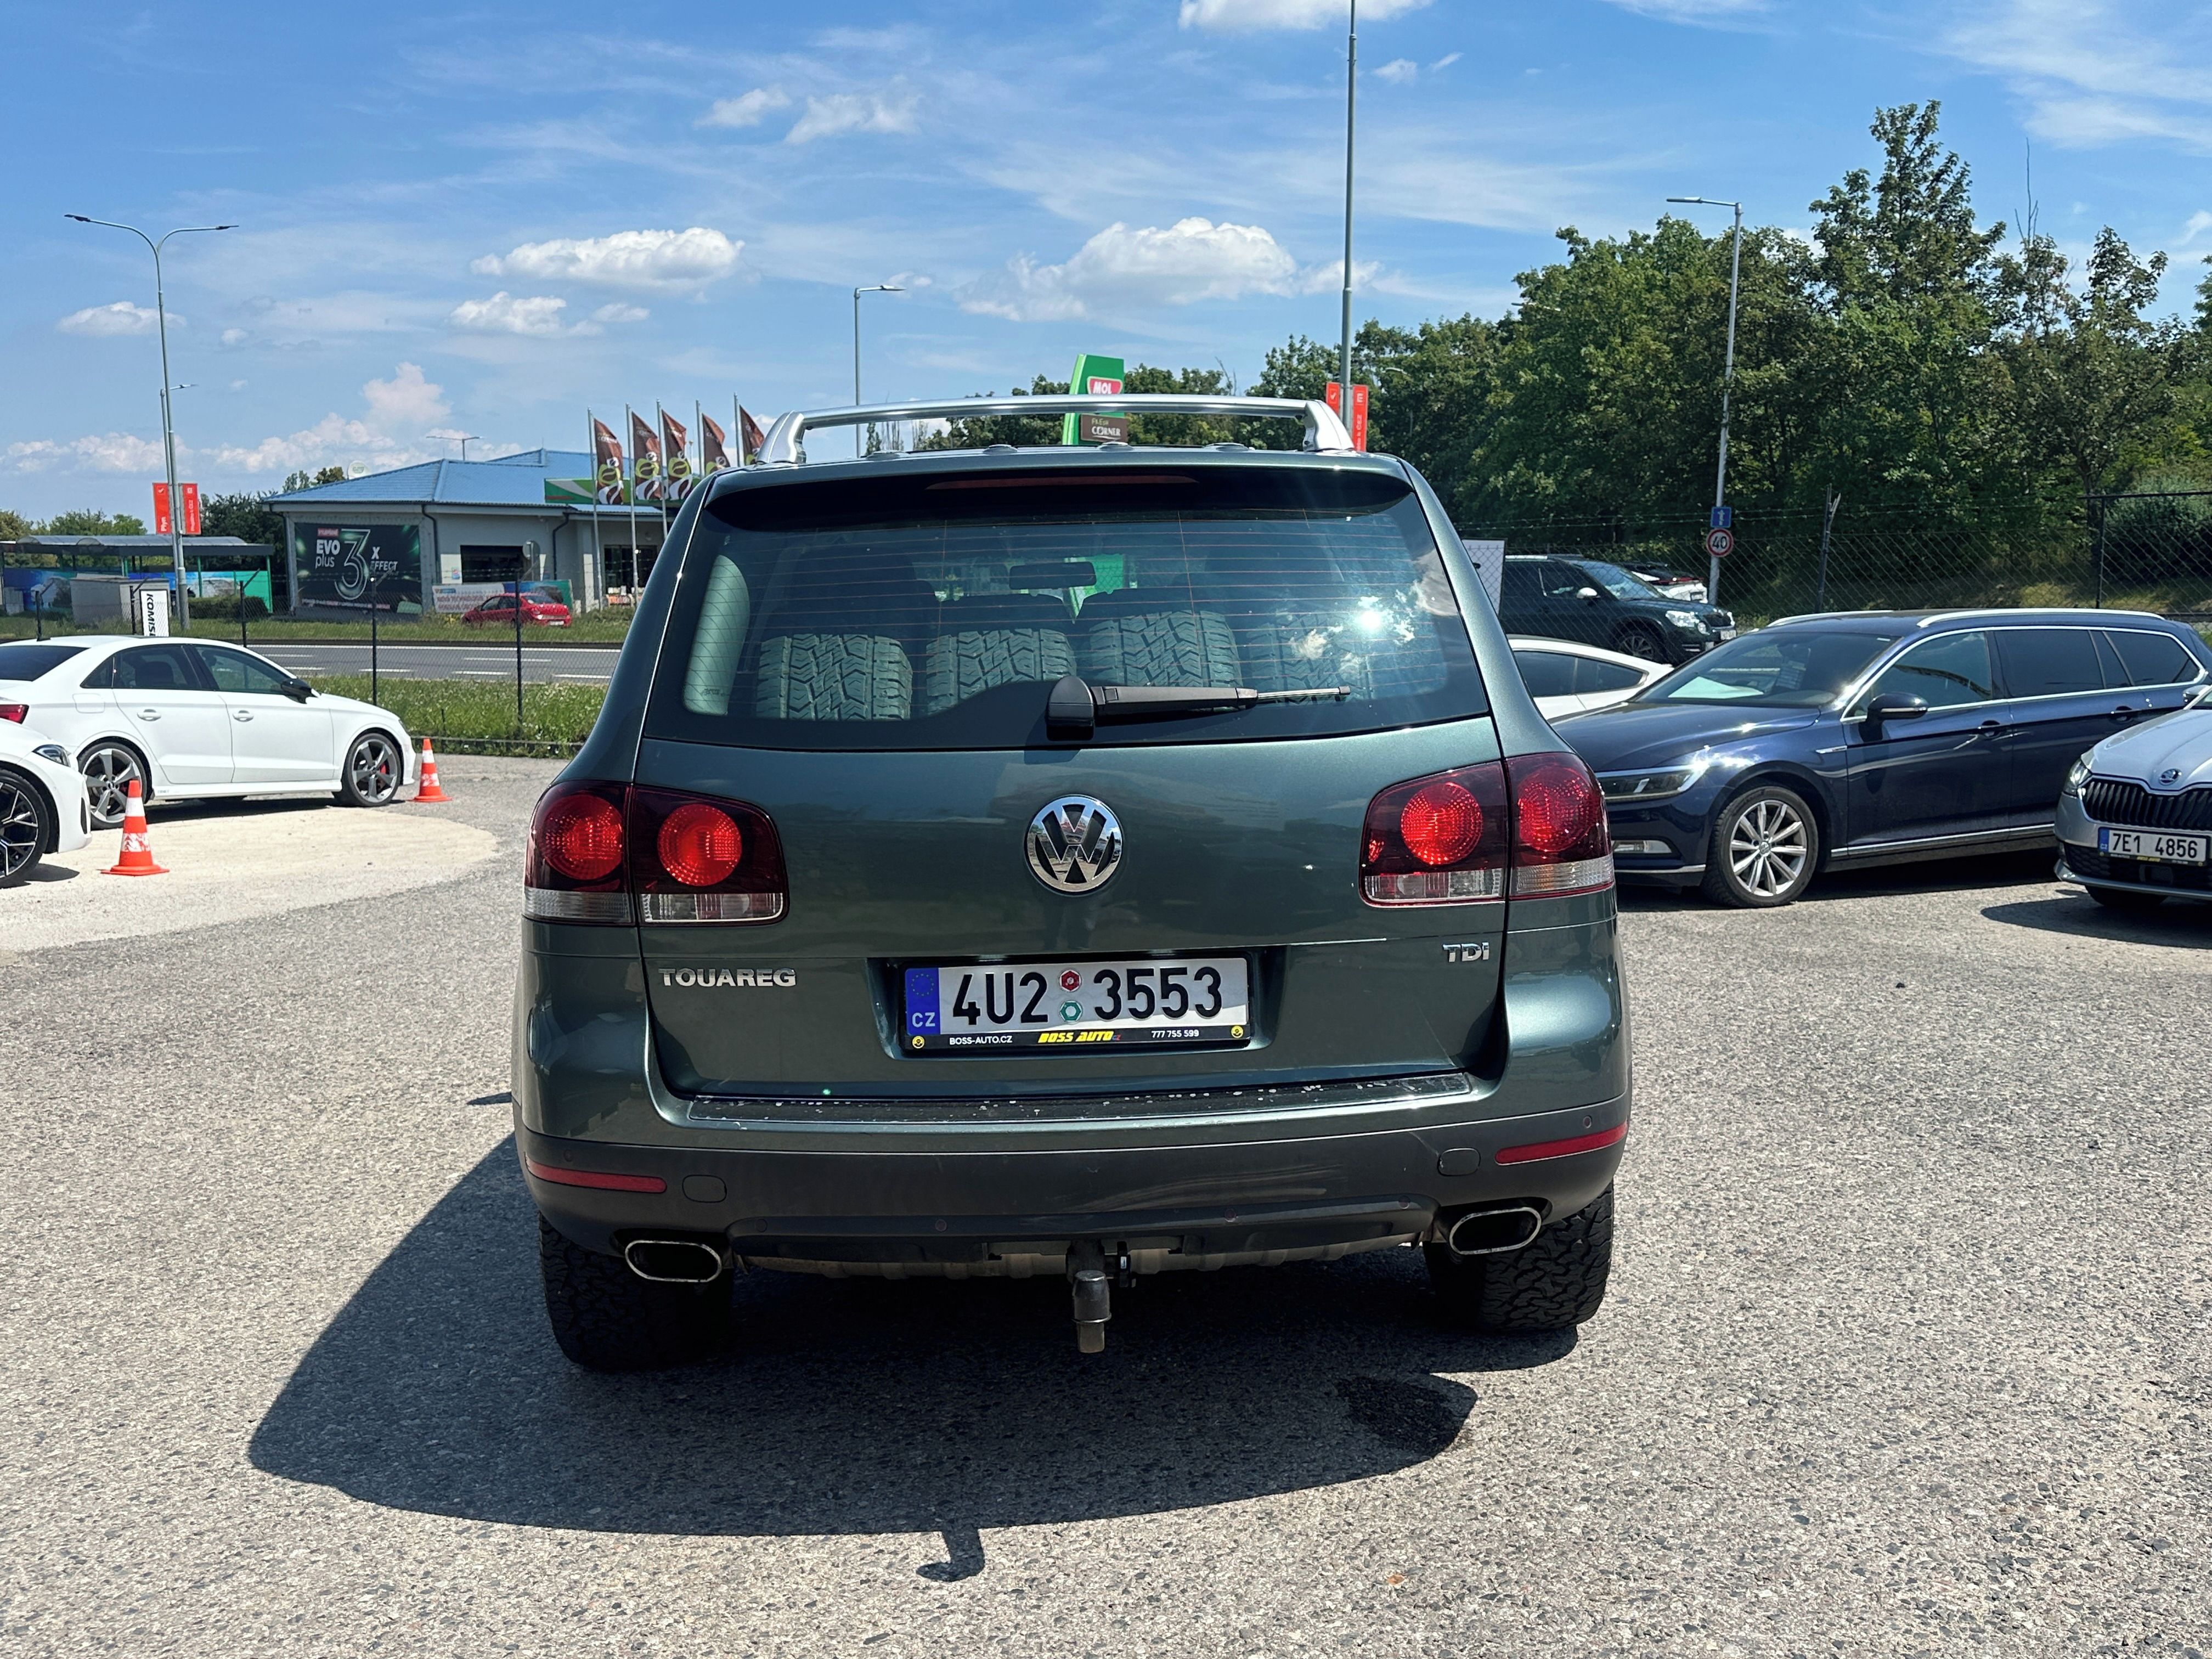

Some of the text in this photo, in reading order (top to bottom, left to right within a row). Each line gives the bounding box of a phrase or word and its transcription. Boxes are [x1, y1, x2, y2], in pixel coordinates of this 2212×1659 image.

[1092, 381, 1112, 394] MOL
[1091, 426, 1121, 436] CORNER
[316, 539, 341, 555] EVO
[1712, 536, 1728, 549] 40
[315, 552, 335, 569] plus
[334, 528, 371, 600] 3
[370, 561, 398, 571] EFFECT
[2113, 833, 2198, 858] 7E1 4856
[658, 968, 797, 987] TOUAREG
[952, 967, 1222, 1025] 4U2 3553
[912, 1012, 936, 1028] CZ
[949, 1036, 1013, 1045] BOSS-AUTO.CZ
[1038, 1032, 1074, 1043] BOSS
[1151, 1030, 1165, 1038] 777
